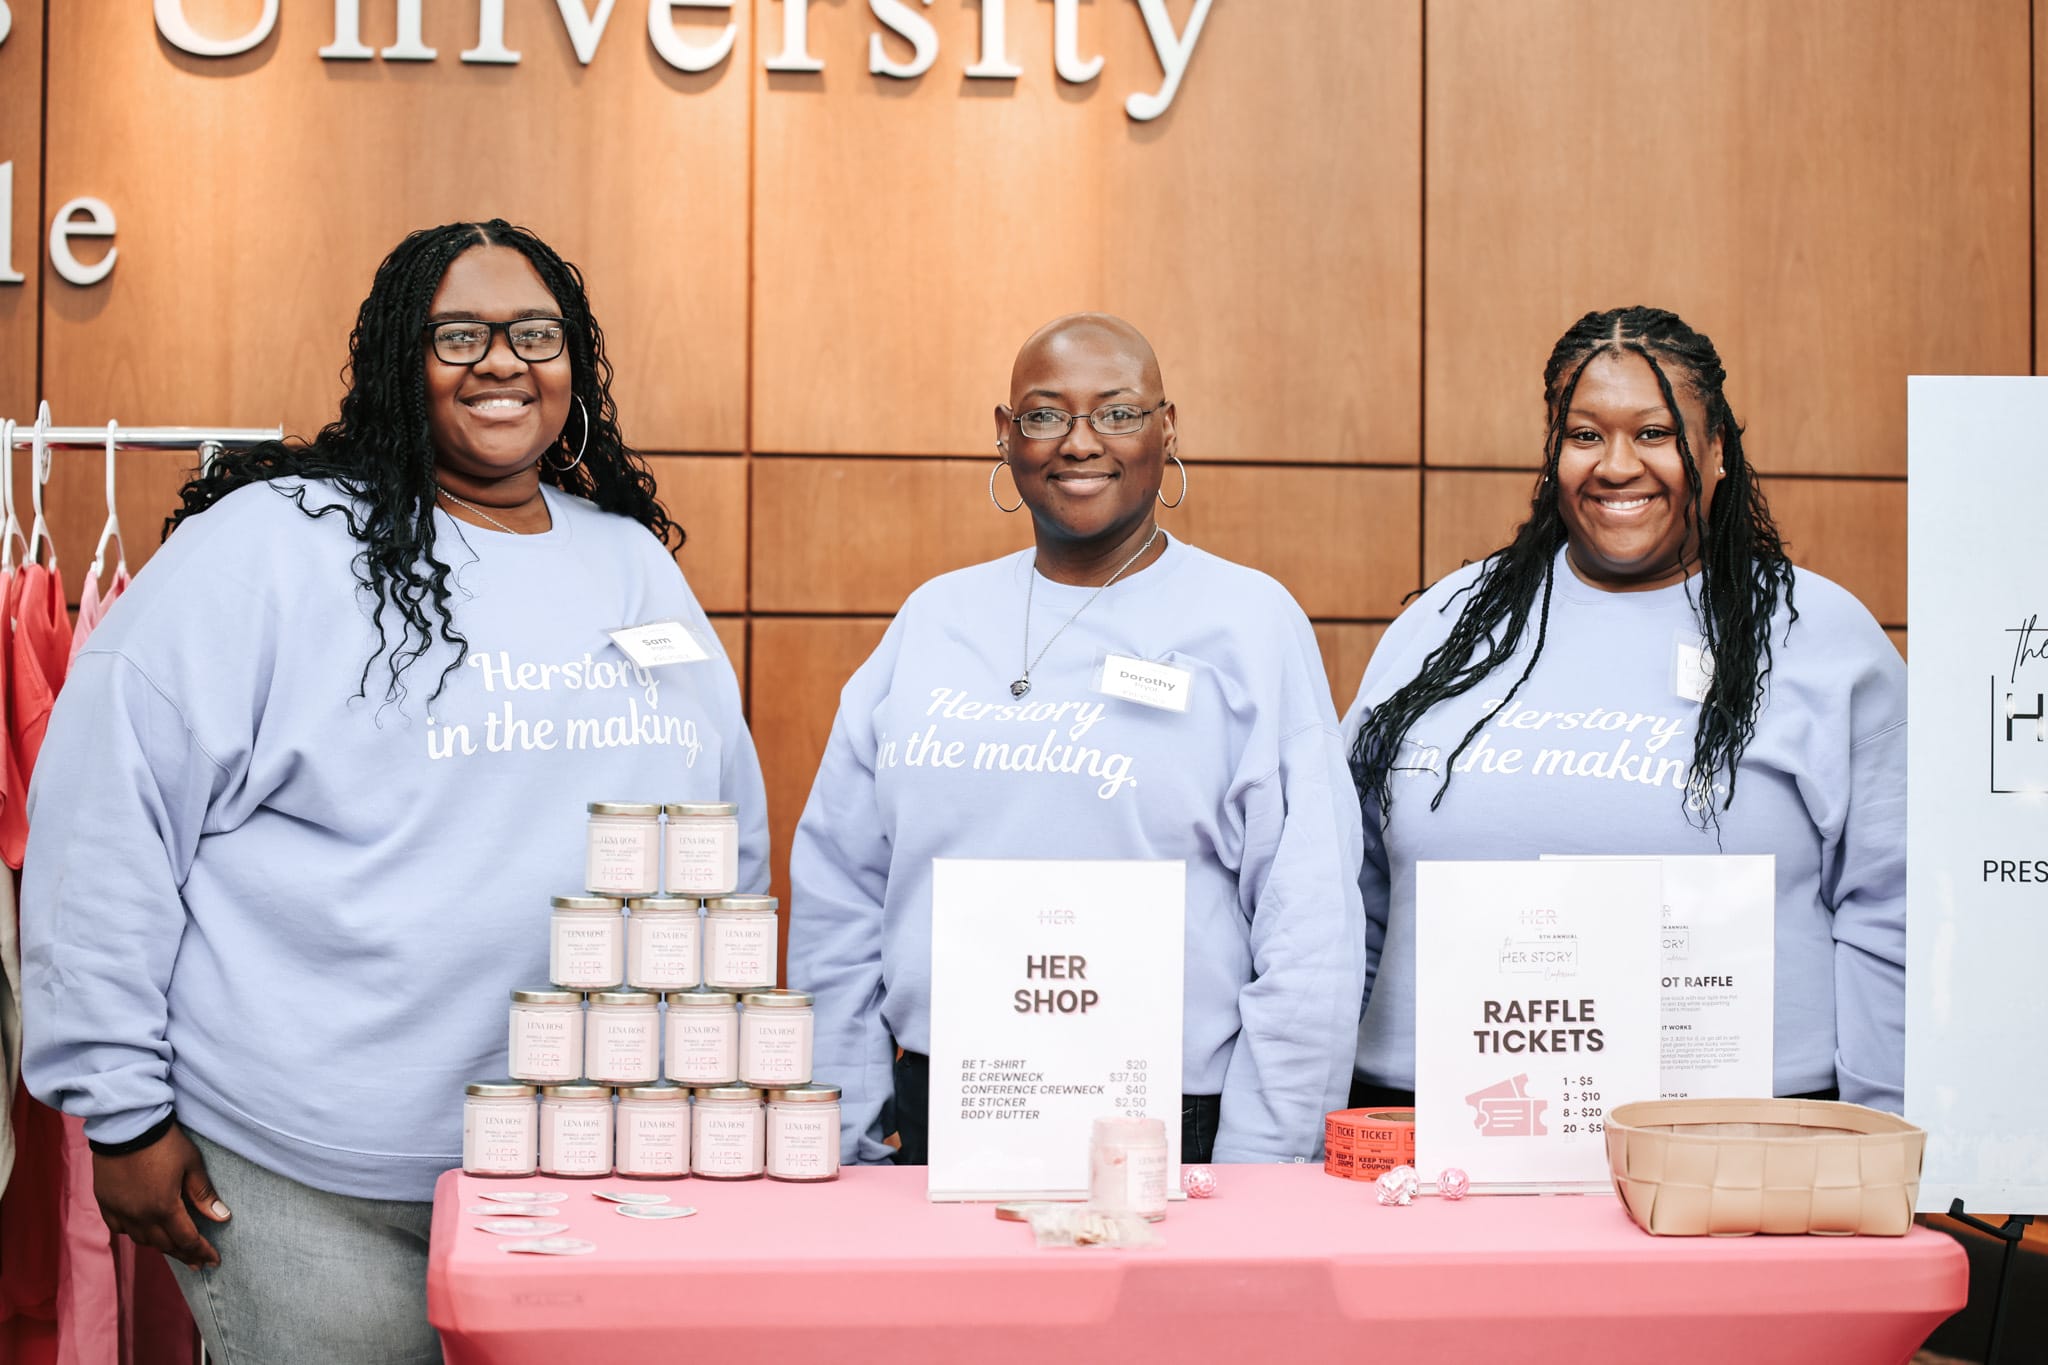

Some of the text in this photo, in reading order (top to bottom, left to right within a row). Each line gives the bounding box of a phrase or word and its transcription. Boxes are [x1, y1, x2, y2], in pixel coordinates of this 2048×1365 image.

[642, 637, 671, 646] Sam
[468, 651, 659, 709] Herstory
[1120, 671, 1176, 691] Dorothy
[926, 687, 1106, 741] Herstory
[426, 717, 477, 760] in
[485, 701, 559, 753] the
[1481, 699, 1684, 751] Herstory
[878, 725, 1138, 800] in the making.
[1037, 910, 1076, 925] HER
[1521, 909, 1558, 925] HER
[1502, 952, 1573, 963] HER STORY
[1027, 955, 1087, 979] HER
[1685, 976, 1733, 987] RAFFLE
[1014, 989, 1099, 1013] SHOP
[1483, 999, 1596, 1024] RAFFLE
[1473, 1029, 1605, 1055] TICKETS
[962, 1060, 976, 1069] BE
[1126, 1060, 1147, 1070] $20
[962, 1073, 1044, 1082] BE CREWNECK
[1110, 1072, 1146, 1082] $37.50
[1563, 1077, 1568, 1086] 1
[1580, 1076, 1593, 1086] $5
[962, 1085, 1105, 1094] CONFERENCE CREWNECK
[1126, 1085, 1146, 1096] $40
[962, 1098, 1026, 1107] BE STICKER
[1563, 1093, 1570, 1102] 3
[1582, 1092, 1600, 1102] $10
[1115, 1098, 1146, 1108] $2.50
[961, 1110, 1040, 1120] BODY BUTTER
[1563, 1108, 1570, 1118] 8
[1582, 1108, 1602, 1118] $20
[1563, 1124, 1577, 1133] 20
[1361, 1130, 1392, 1140] TICKET
